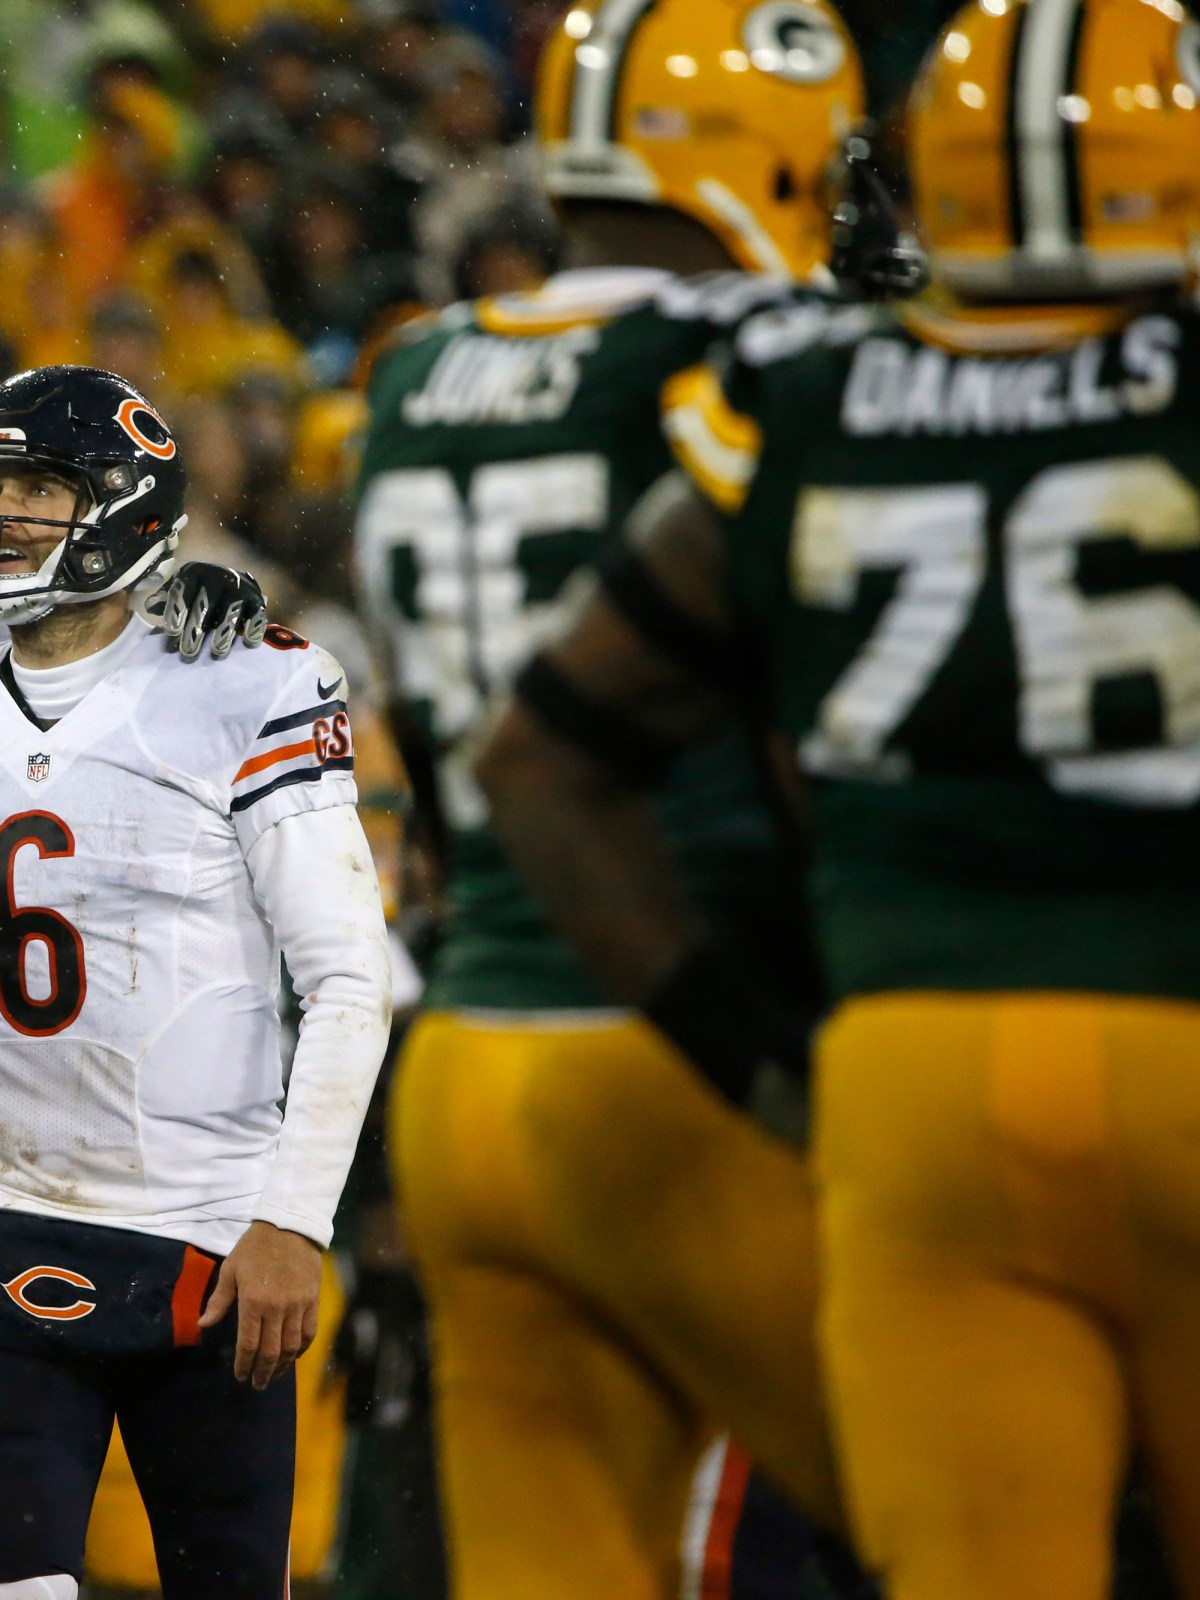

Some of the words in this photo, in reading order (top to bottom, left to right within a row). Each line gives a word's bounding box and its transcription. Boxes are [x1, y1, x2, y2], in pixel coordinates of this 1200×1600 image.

[840, 315, 1178, 436] DANIELS
[113, 398, 176, 460] C
[790, 455, 1200, 808] 76
[0, 1265, 96, 1320] C
